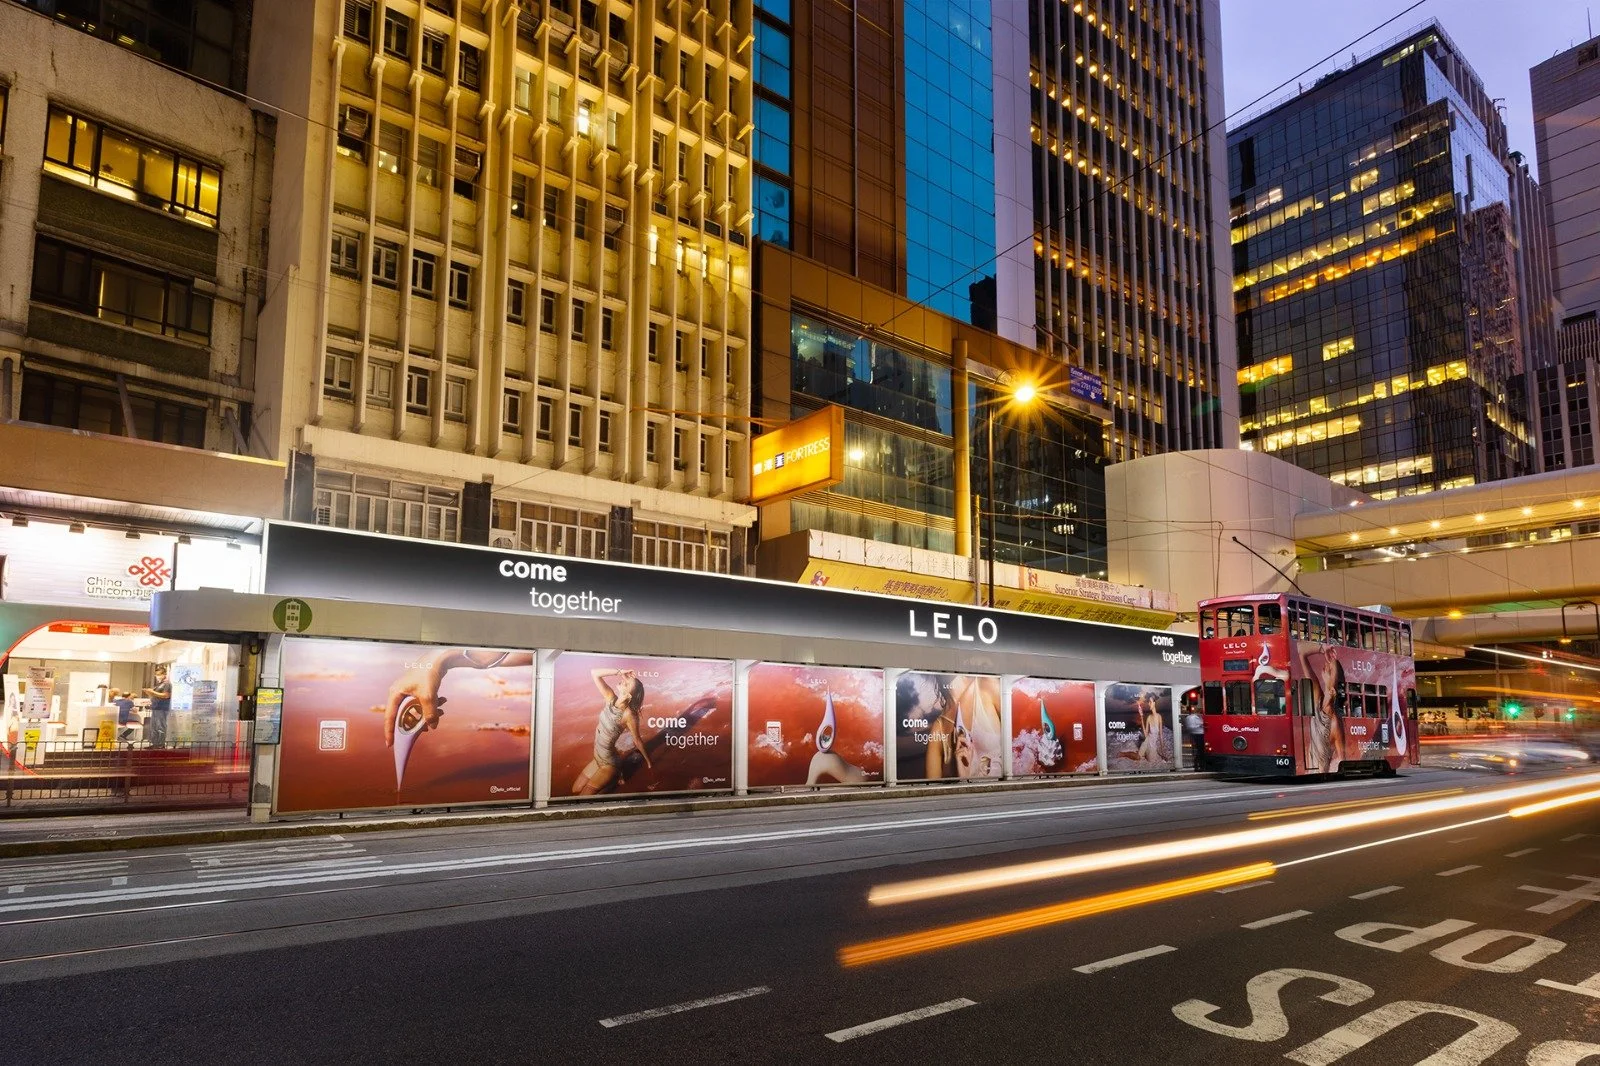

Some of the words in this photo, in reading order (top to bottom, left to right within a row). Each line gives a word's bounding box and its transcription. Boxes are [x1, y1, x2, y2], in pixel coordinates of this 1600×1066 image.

[785, 437, 830, 464] FORTRESS
[499, 559, 568, 583] come
[87, 576, 122, 587] China
[87, 586, 132, 597] unicom
[1055, 584, 1078, 597] Superior
[1078, 588, 1100, 600] Strategy
[1101, 591, 1122, 603] Business
[530, 586, 622, 614] together
[909, 610, 998, 645] LELO
[1151, 634, 1174, 647] come
[1162, 649, 1193, 665] together
[404, 662, 433, 670] LELO
[1352, 660, 1372, 672] LELO
[647, 716, 687, 728] come
[902, 718, 928, 728] come
[1108, 721, 1126, 730] come
[1116, 731, 1141, 743] together
[1350, 725, 1367, 736] come
[665, 732, 719, 749] together
[914, 732, 949, 745] together
[1358, 740, 1380, 753] together
